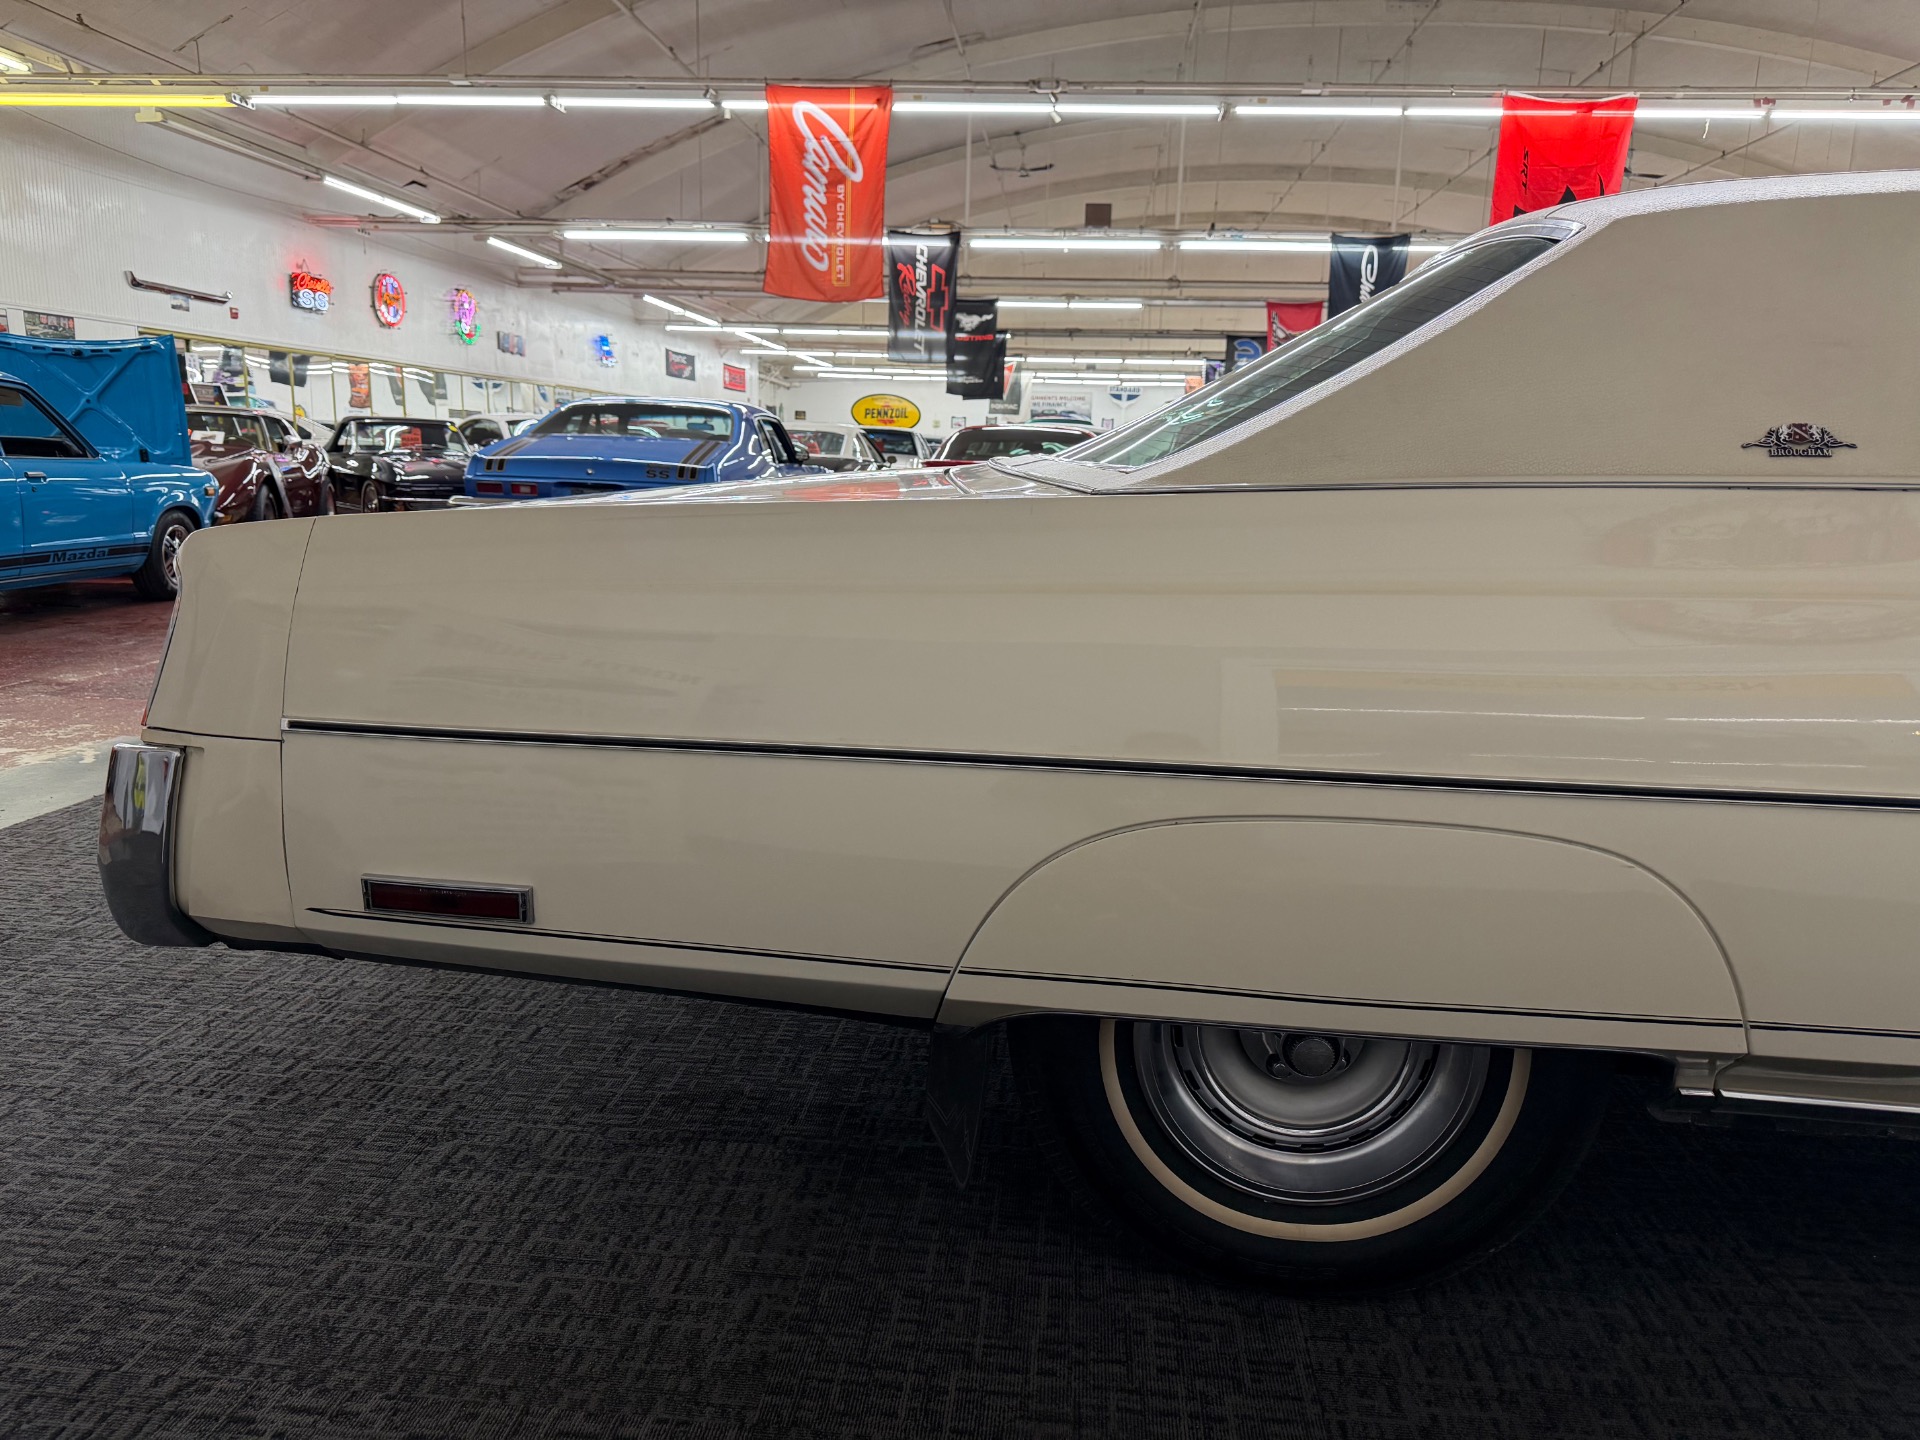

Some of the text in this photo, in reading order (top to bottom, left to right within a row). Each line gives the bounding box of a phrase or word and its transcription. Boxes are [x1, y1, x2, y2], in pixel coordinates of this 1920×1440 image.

[792, 101, 864, 272] Camaro
[1520, 145, 1529, 196] SRT
[836, 183, 845, 281] BY CHEVROLET
[298, 288, 330, 311] SS
[896, 262, 917, 327] Racing
[914, 243, 929, 355] CHEVROLET
[864, 407, 909, 419] PENNZOIL
[1771, 448, 1832, 456] BROUGHAM
[645, 468, 670, 479] SS
[51, 547, 109, 563] Mazda
